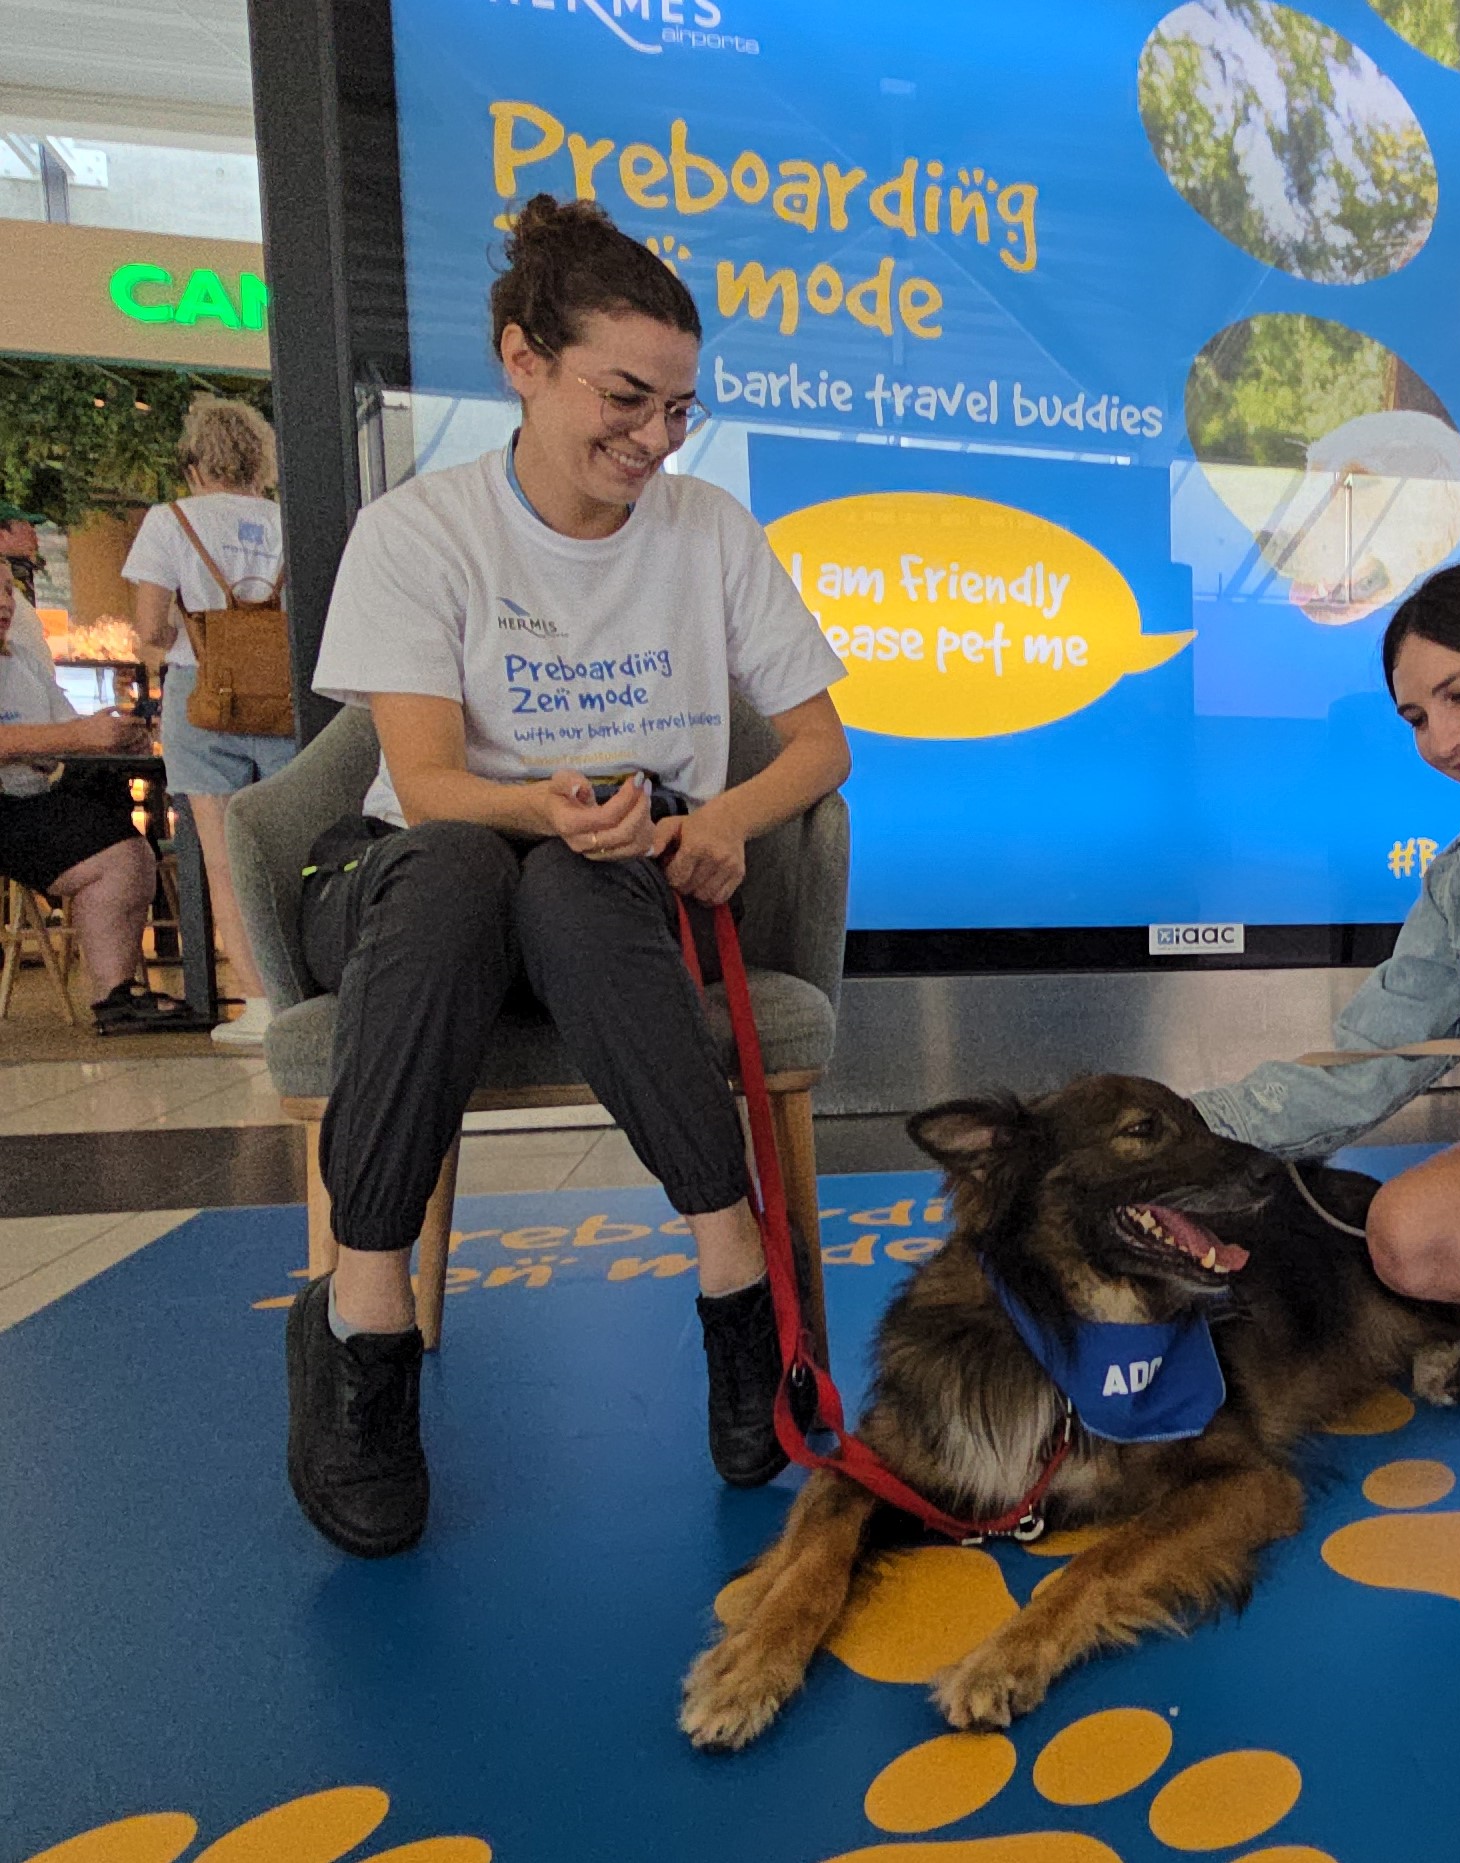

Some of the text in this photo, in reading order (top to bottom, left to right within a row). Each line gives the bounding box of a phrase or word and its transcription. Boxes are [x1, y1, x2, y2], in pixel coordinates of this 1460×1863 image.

[489, 101, 1039, 273] Preboarding
[715, 256, 944, 338] mode
[714, 357, 1164, 438] barkie travel buddies
[817, 563, 885, 604] am
[504, 650, 673, 683] Preboarding
[812, 611, 1089, 677] ease pet me
[508, 683, 649, 714] Zen mode
[514, 728, 556, 747] with
[559, 728, 582, 740] our
[587, 719, 635, 739] barkie
[640, 711, 686, 737] travel
